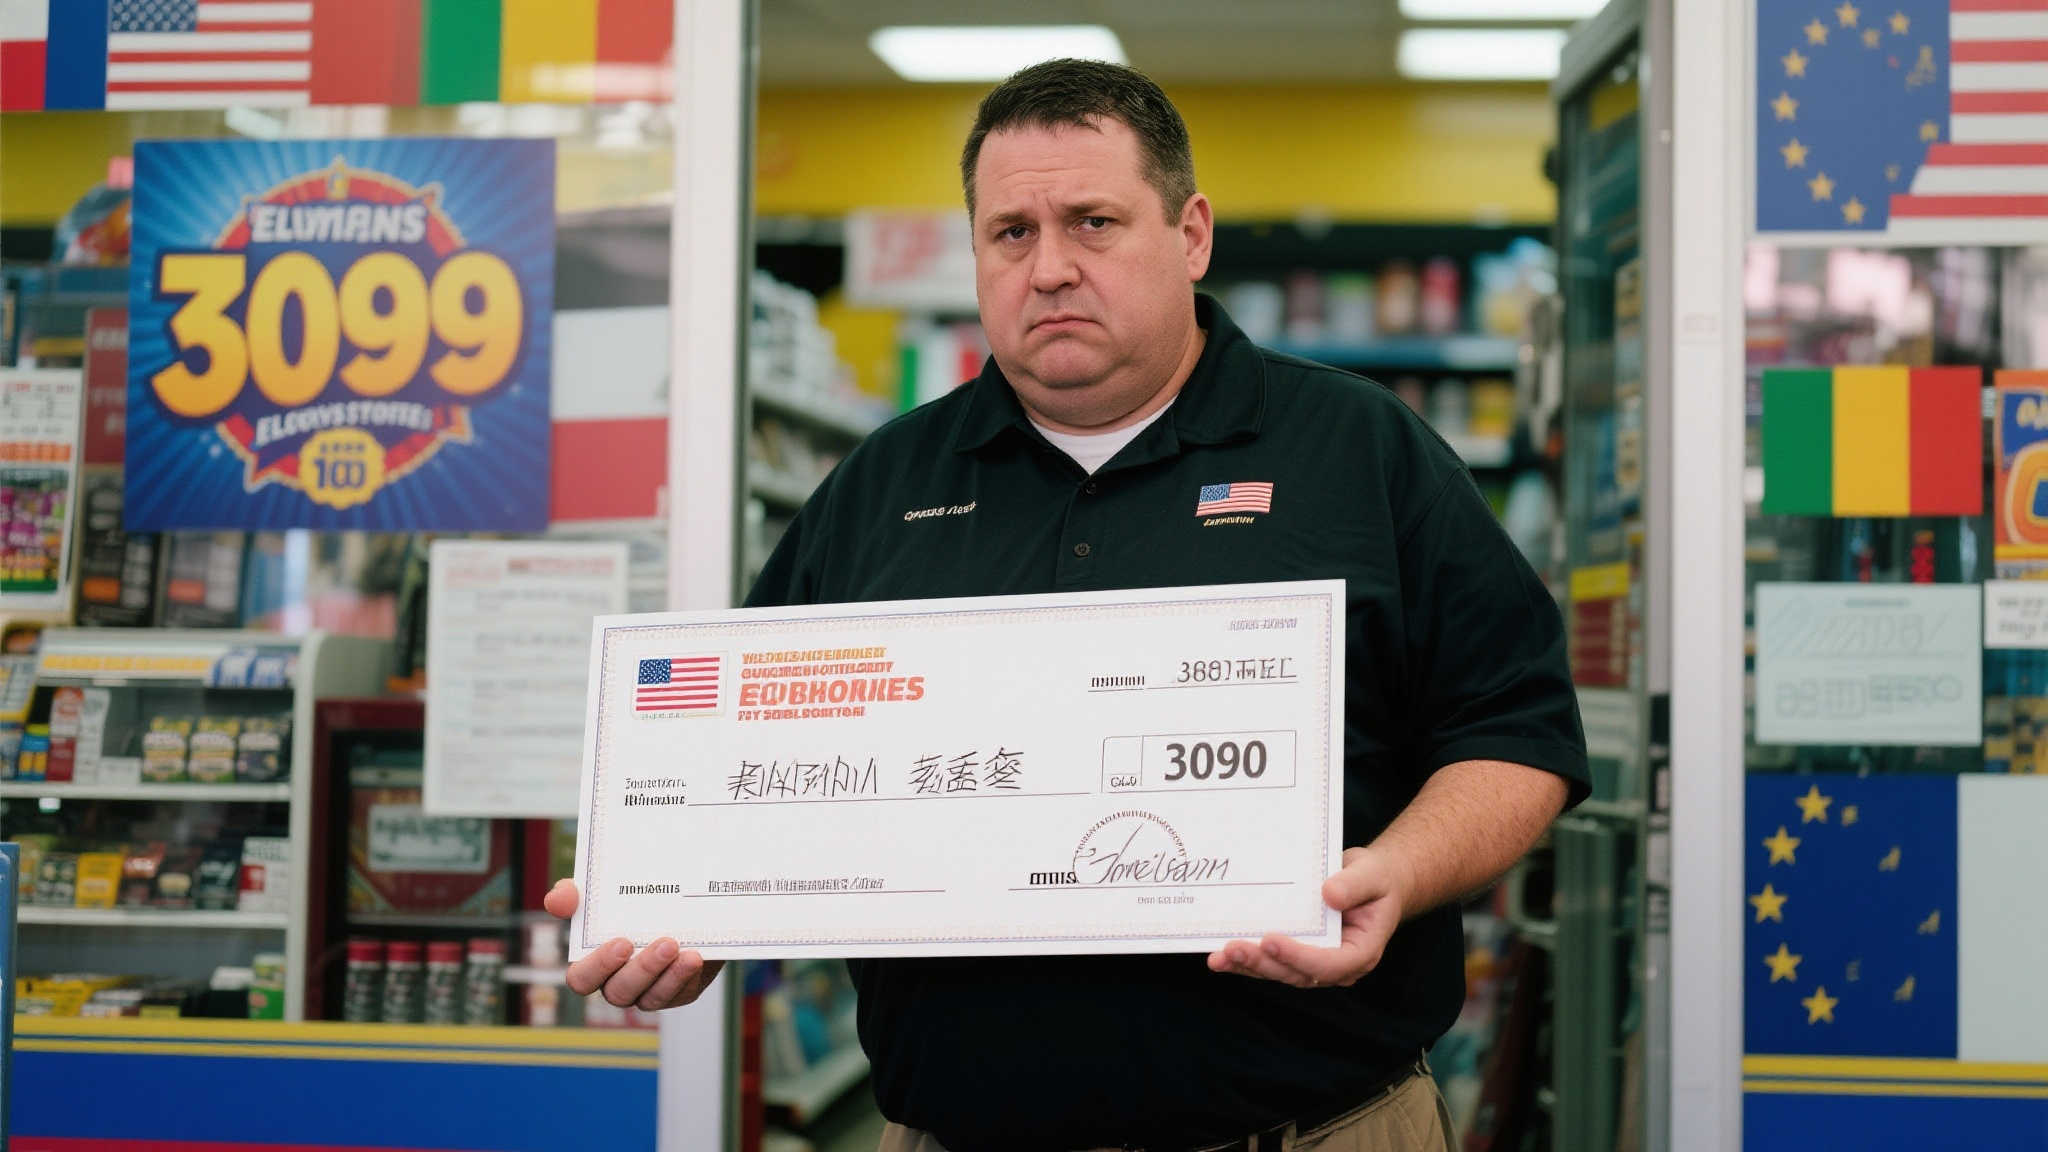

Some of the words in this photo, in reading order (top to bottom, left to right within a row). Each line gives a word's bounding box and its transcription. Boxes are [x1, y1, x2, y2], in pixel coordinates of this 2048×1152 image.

[151, 251, 524, 418] 3099
[313, 457, 367, 490] 100
[1164, 740, 1268, 781] 3090
